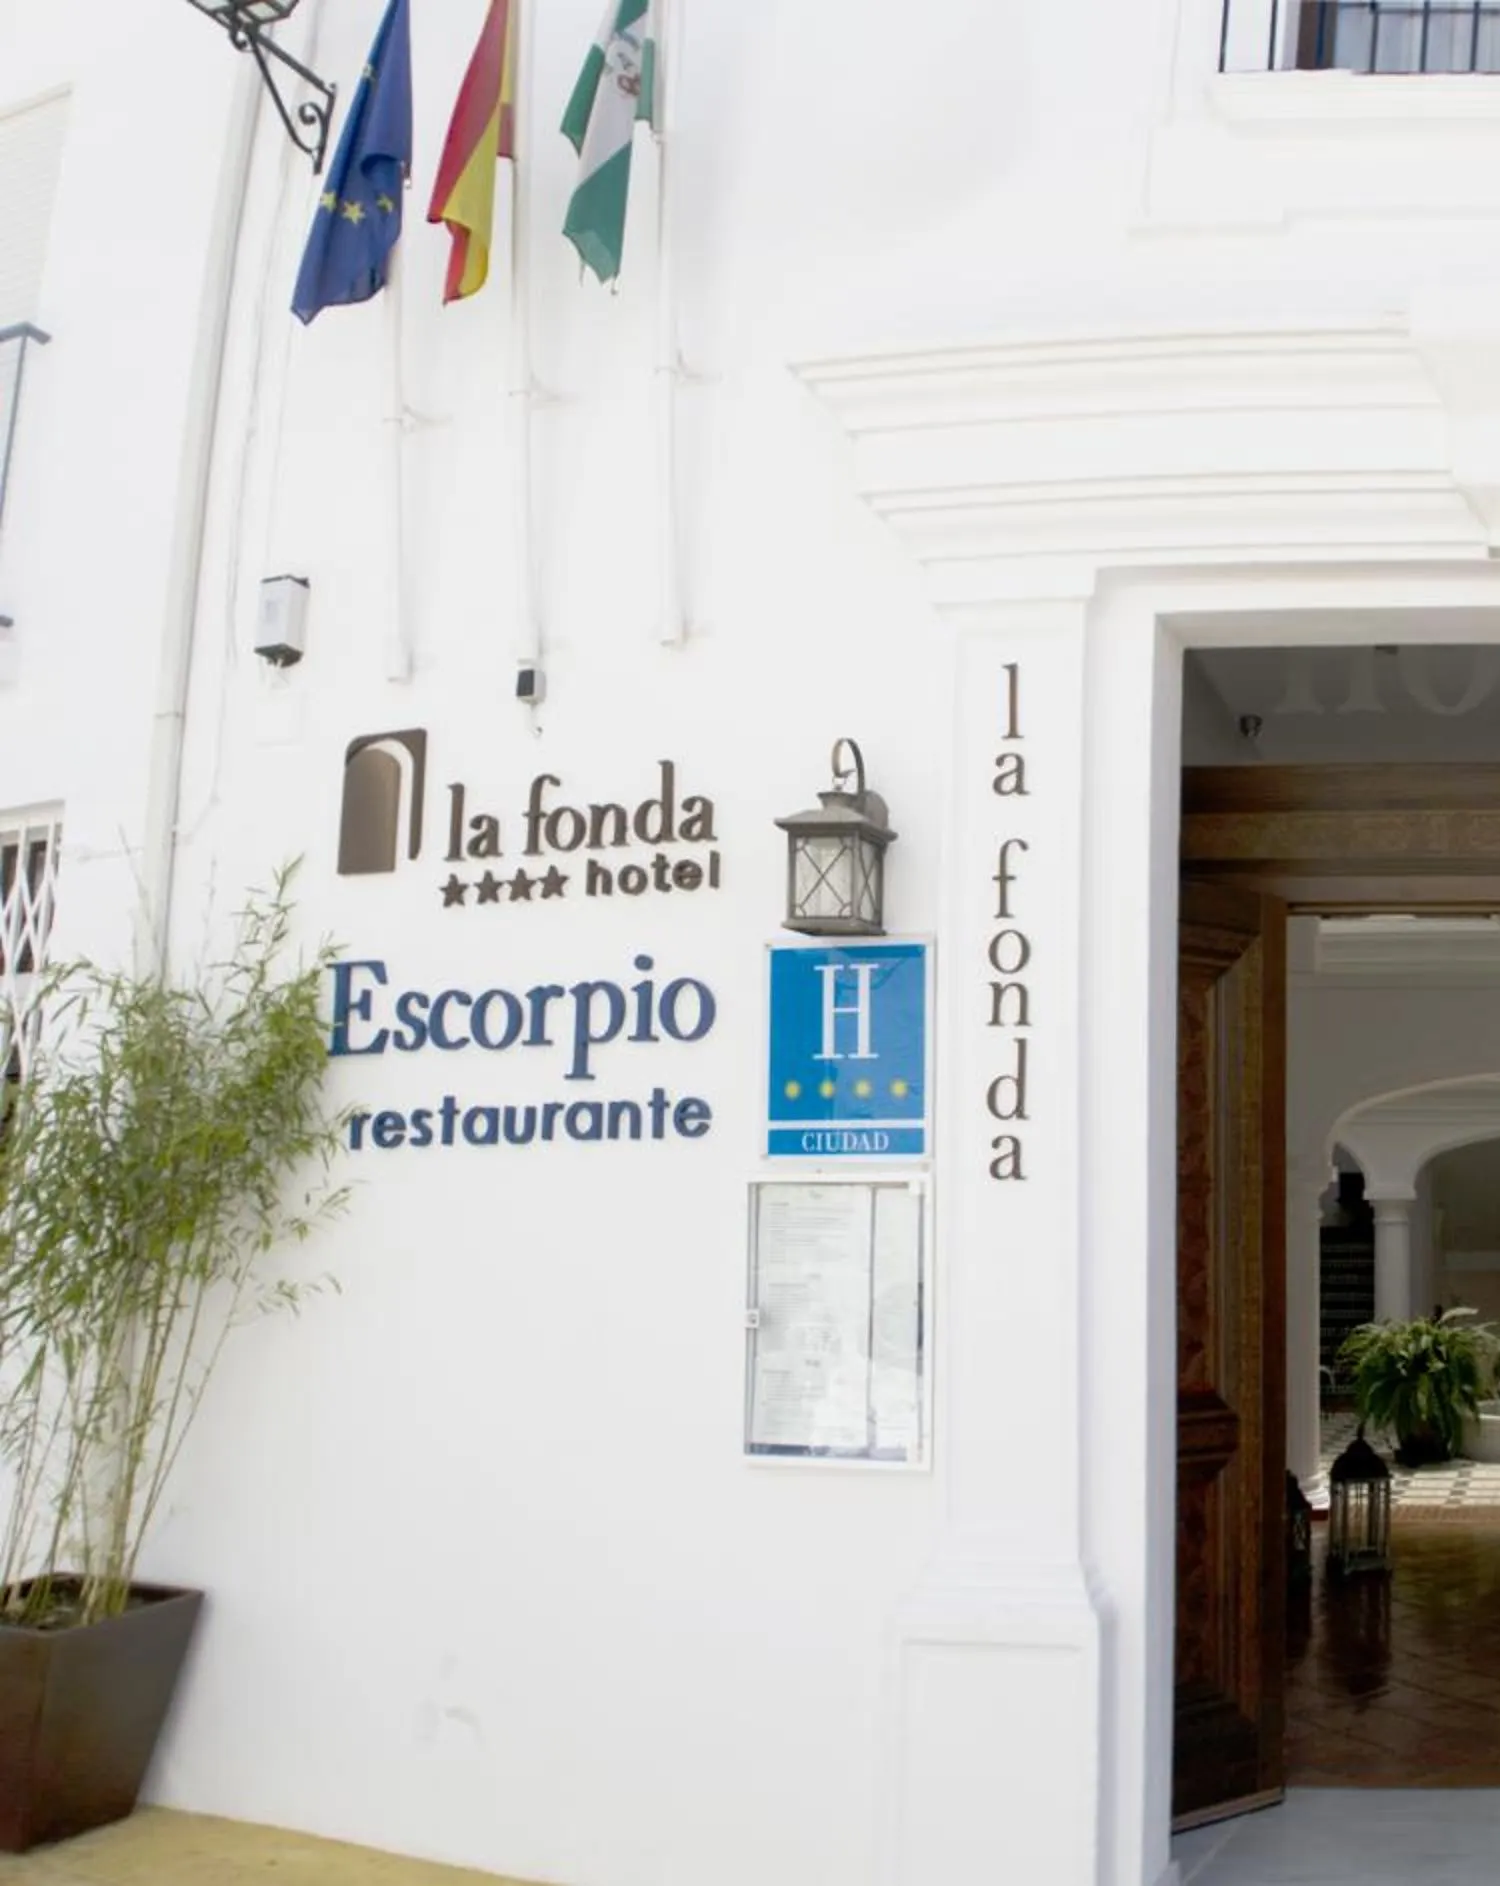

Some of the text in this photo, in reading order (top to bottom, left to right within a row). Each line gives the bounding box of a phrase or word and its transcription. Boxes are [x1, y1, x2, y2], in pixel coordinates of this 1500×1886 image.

[443, 759, 720, 862] la fonda
[585, 850, 721, 897] hotel
[986, 661, 1032, 1181] la fonda
[326, 953, 717, 1081] Escorpio
[812, 962, 880, 1061] H
[349, 1087, 713, 1151] restaurante
[801, 1131, 890, 1152] CIUDAD
